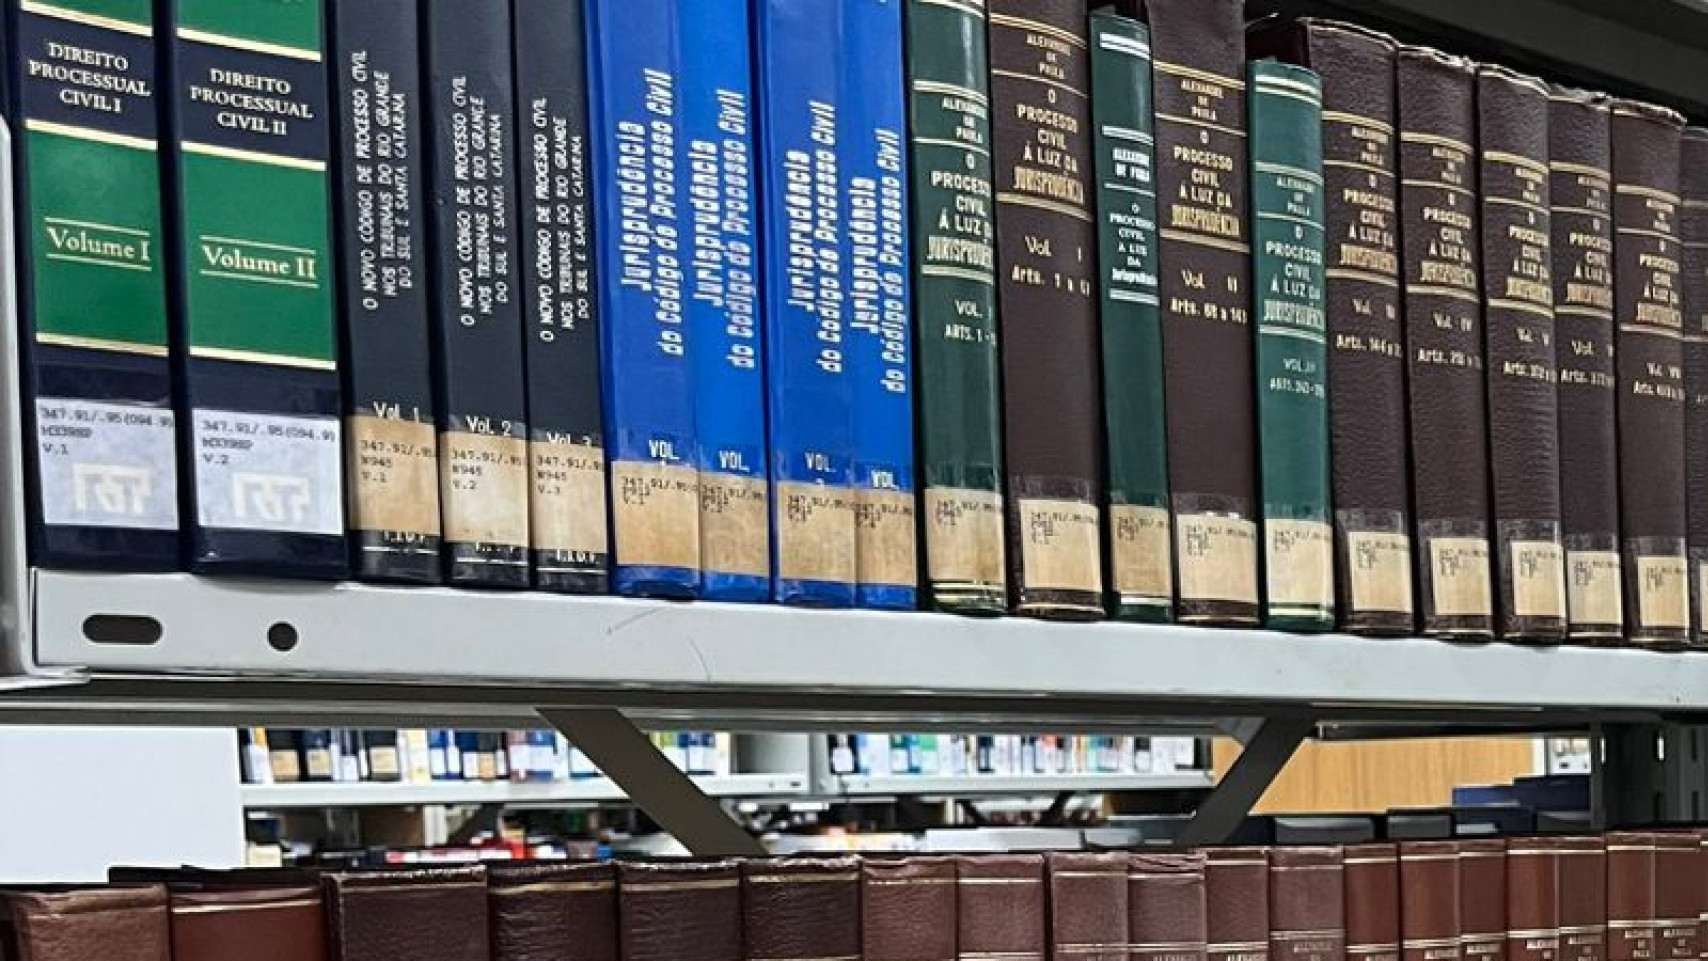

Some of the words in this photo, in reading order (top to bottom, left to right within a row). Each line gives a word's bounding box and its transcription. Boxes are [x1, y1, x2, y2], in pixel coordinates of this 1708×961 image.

[48, 42, 129, 71] DIREITO
[351, 51, 367, 82] CIVIL
[28, 59, 151, 97] PROCESSUAL
[210, 67, 291, 95] DIREITO
[452, 75, 467, 107] CIVIL
[644, 67, 673, 116] Civil
[59, 88, 111, 113] CIVIL
[190, 85, 314, 119] PROCESSUAL
[374, 70, 390, 127] GRANDE
[532, 98, 547, 128] CIVIL
[716, 89, 746, 134] Civil
[217, 112, 270, 134] CIVIL
[352, 89, 371, 159] PROCESSO
[469, 95, 486, 150] GRANDE
[809, 100, 836, 146] Civil
[376, 132, 392, 159] RIO
[452, 112, 470, 181] PROCESSO
[553, 116, 568, 169] GRANDE
[1037, 129, 1067, 149] CIVIL
[472, 155, 488, 180] RIO
[533, 134, 550, 200] PROCESSO
[650, 120, 676, 220] Processo
[1038, 146, 1060, 167] LUZ
[356, 165, 372, 185] DE
[377, 163, 393, 185] DO
[394, 166, 409, 211] SANTA
[721, 139, 750, 235] Processo
[456, 186, 471, 206] DE
[474, 185, 488, 207] DO
[491, 185, 505, 228] SANTA
[813, 149, 838, 244] Processo
[379, 192, 395, 259] TRIBUNAIS
[535, 205, 551, 224] DE
[556, 204, 571, 225] DO
[46, 226, 135, 259] Volume
[140, 240, 150, 262] I
[475, 212, 492, 279] TRIBUNAIS
[202, 245, 290, 275] Volume
[297, 257, 316, 279] II
[360, 249, 378, 291] NOVO
[399, 266, 413, 289] DO
[558, 230, 573, 294] TRIBUNAIS
[381, 266, 398, 297] NOS
[458, 268, 474, 309] NOVO
[495, 281, 508, 304] DO
[363, 297, 378, 310] O
[477, 285, 493, 315] NOS
[538, 284, 554, 325] NOVO
[560, 301, 575, 330] NOS
[460, 313, 475, 327] O
[539, 330, 554, 342] O
[657, 330, 683, 356] do
[726, 343, 755, 369] do
[816, 348, 842, 373] do
[501, 420, 512, 437] 2
